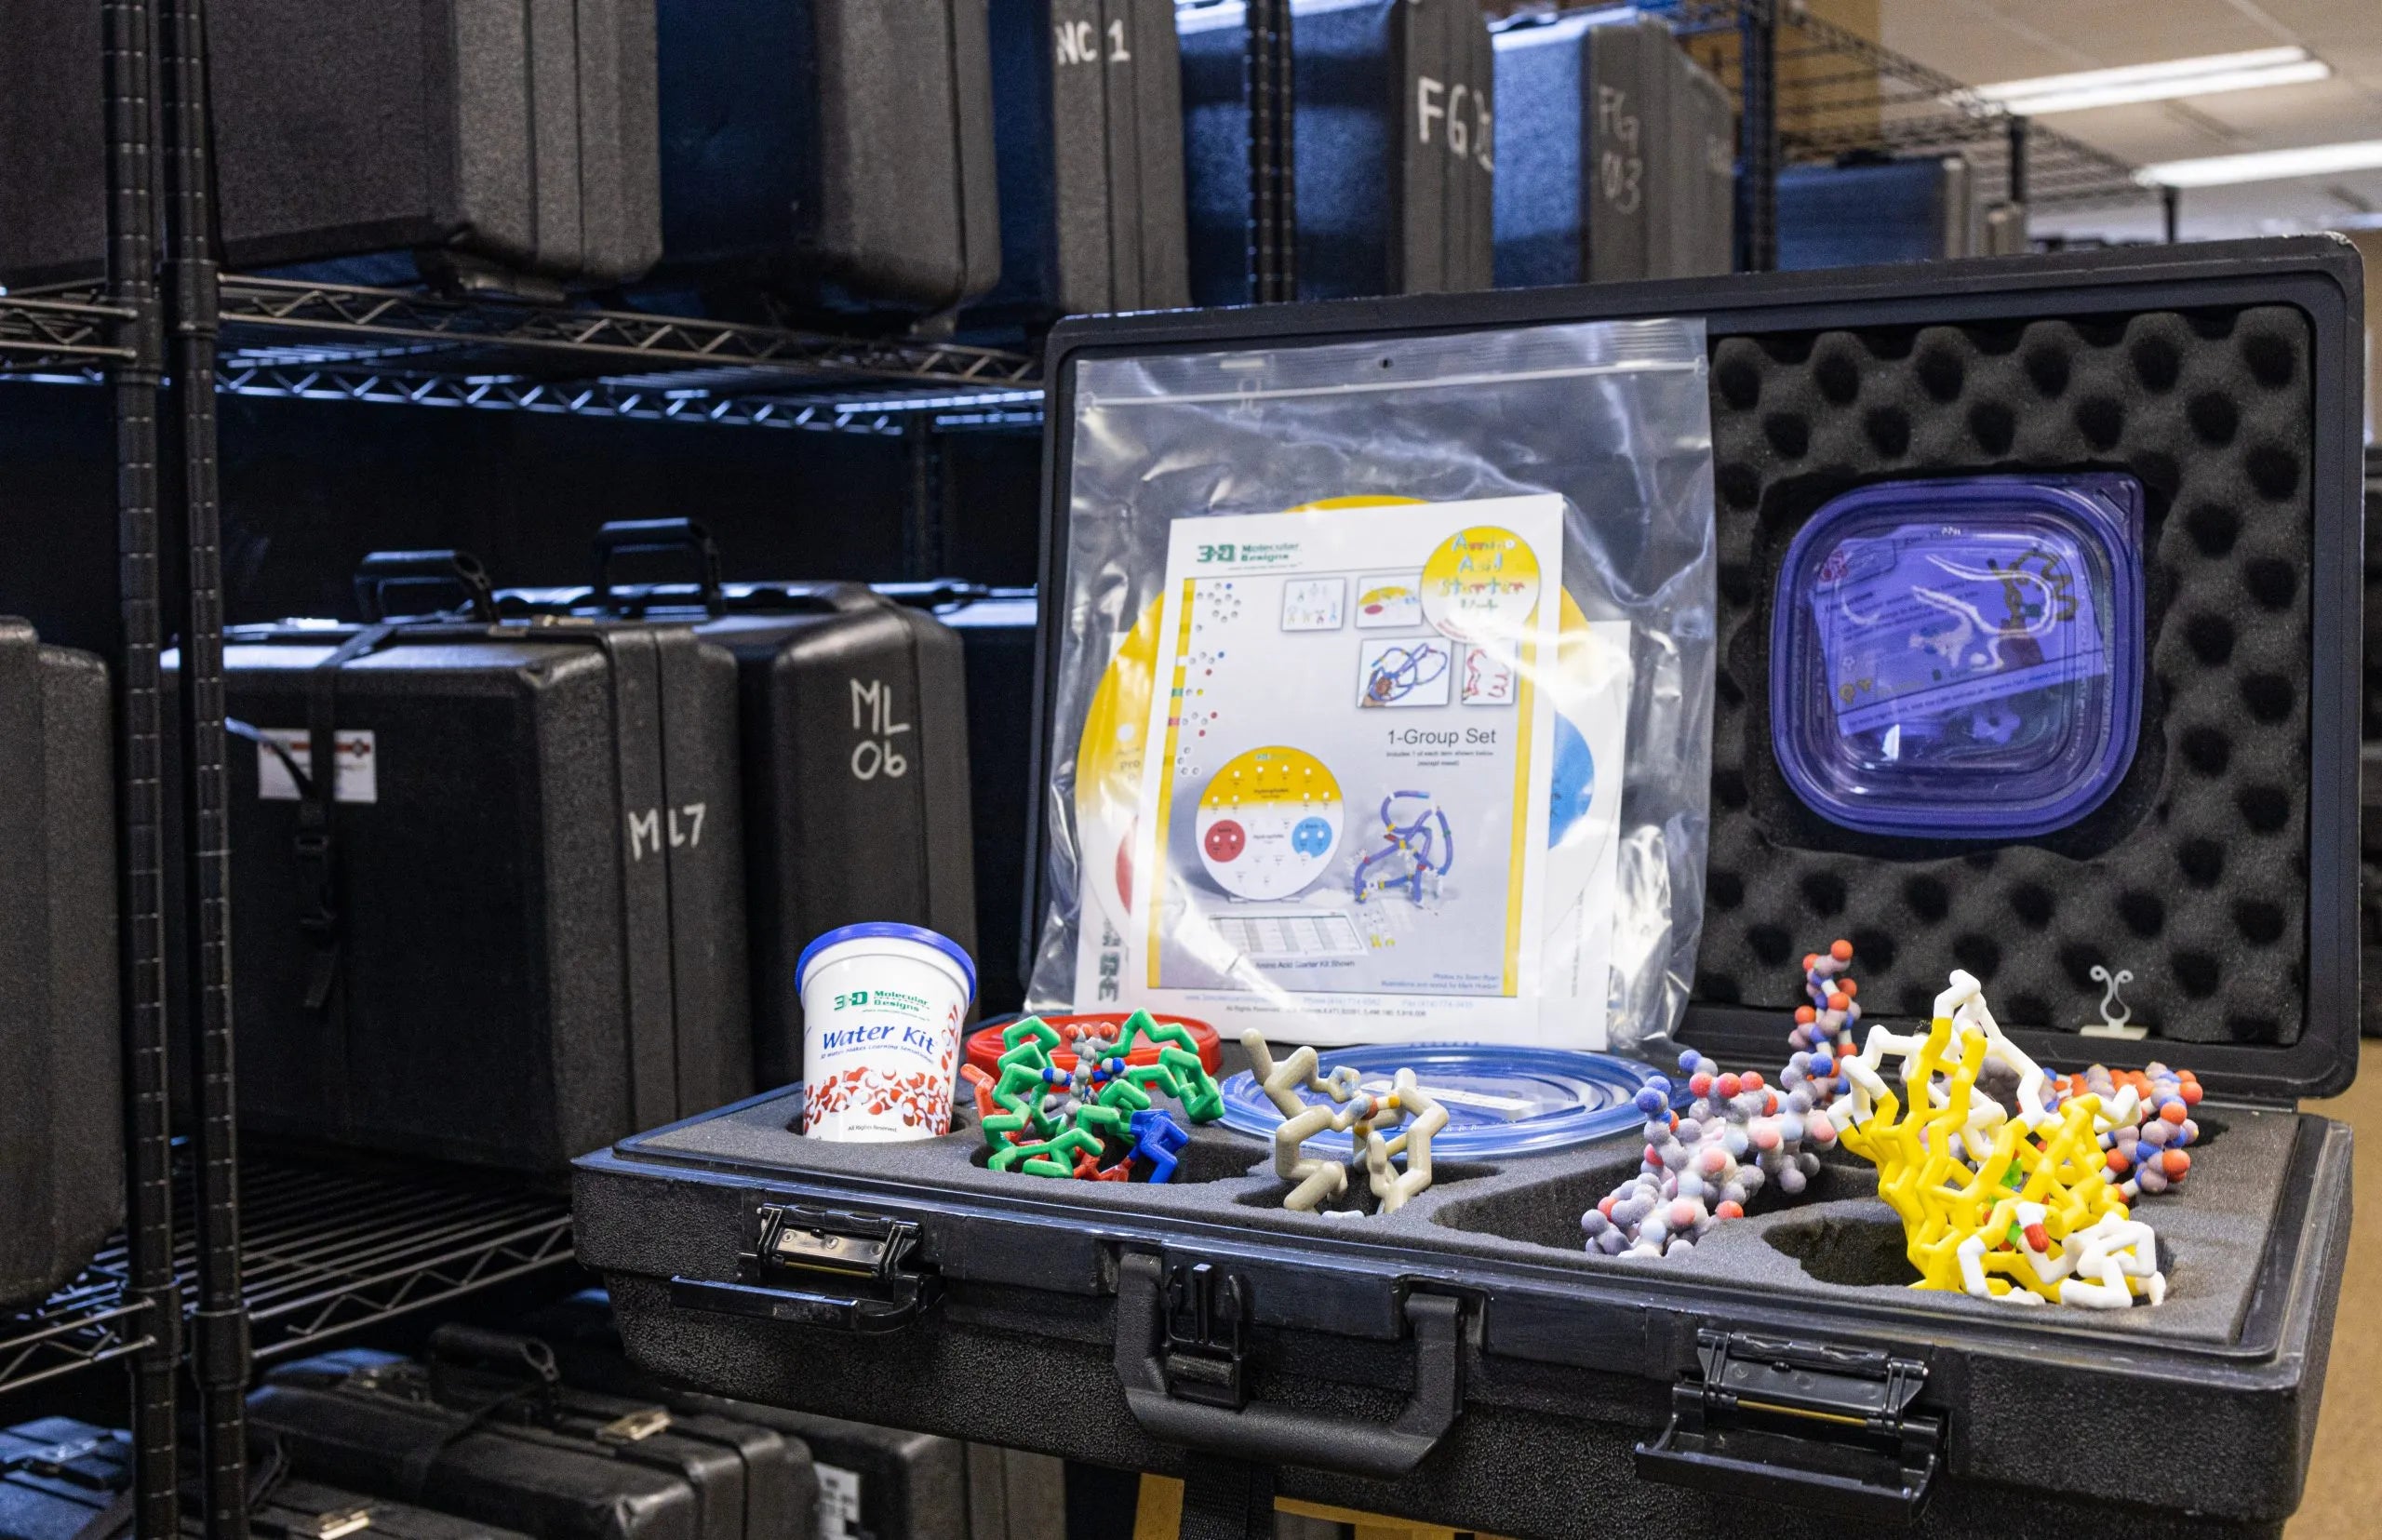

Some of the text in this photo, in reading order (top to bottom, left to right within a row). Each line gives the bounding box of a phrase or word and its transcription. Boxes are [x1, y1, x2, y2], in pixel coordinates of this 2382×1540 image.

[1054, 18, 1132, 66] NC 1
[850, 677, 911, 736] ML
[1387, 728, 1497, 748] 1-Group Set
[834, 990, 929, 1011] 3-D Molecular
[874, 999, 919, 1011] Designs
[823, 1025, 935, 1055] Water Kit
